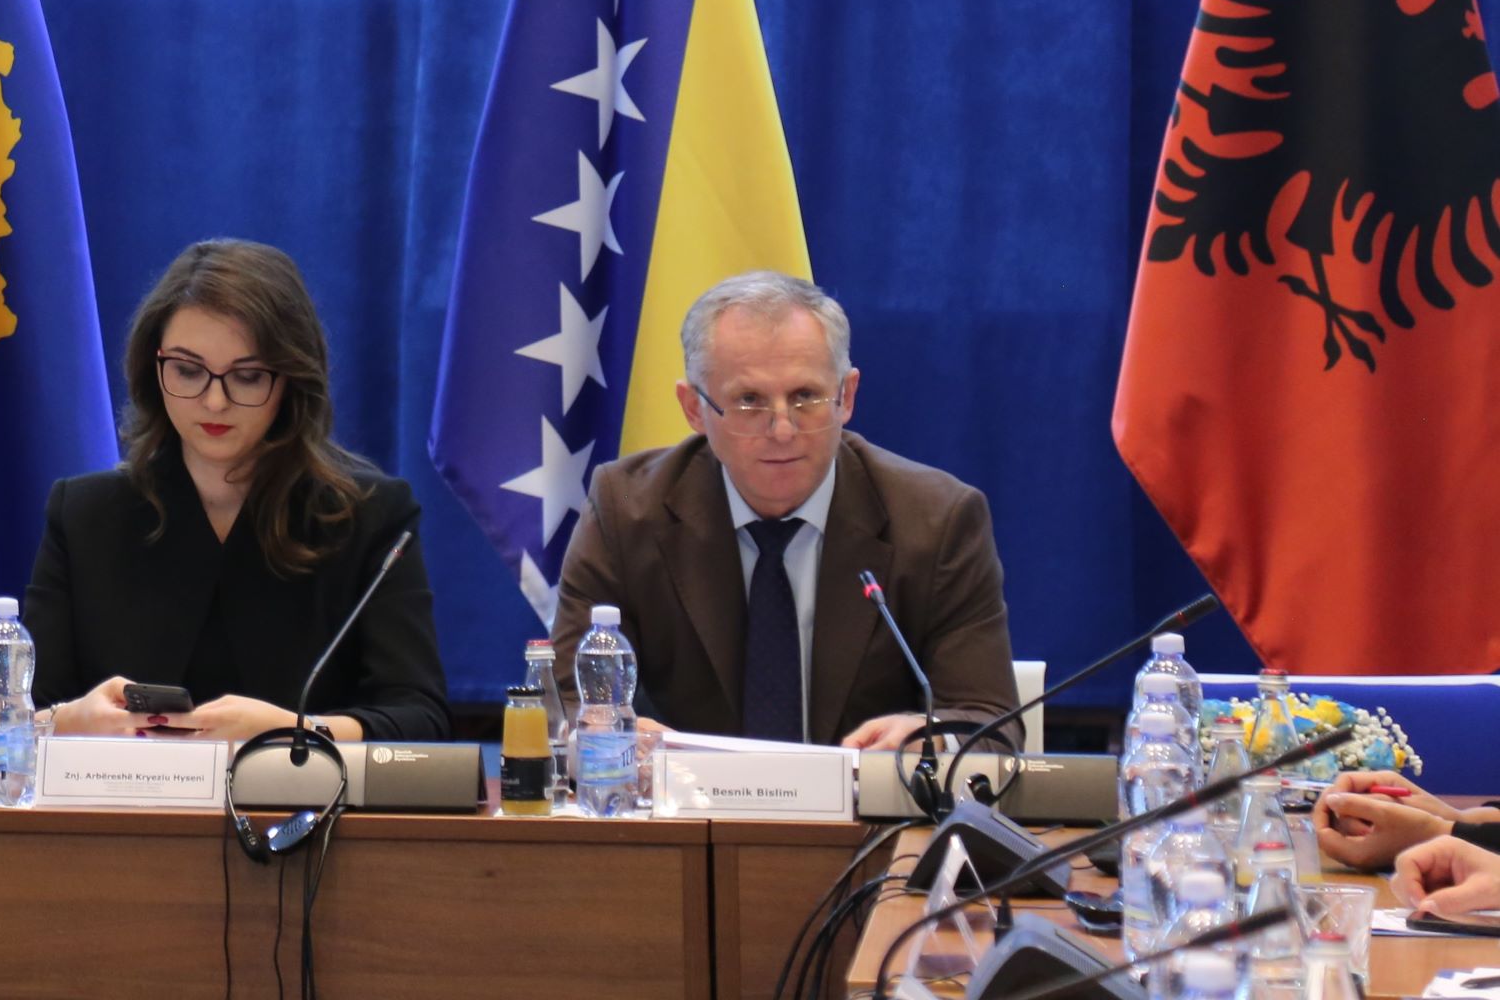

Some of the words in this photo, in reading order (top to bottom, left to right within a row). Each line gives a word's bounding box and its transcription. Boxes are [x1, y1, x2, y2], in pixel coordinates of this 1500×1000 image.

[173, 774, 205, 784] Hyseni
[712, 787, 752, 797] Besnik
[756, 788, 798, 798] Bislimi
